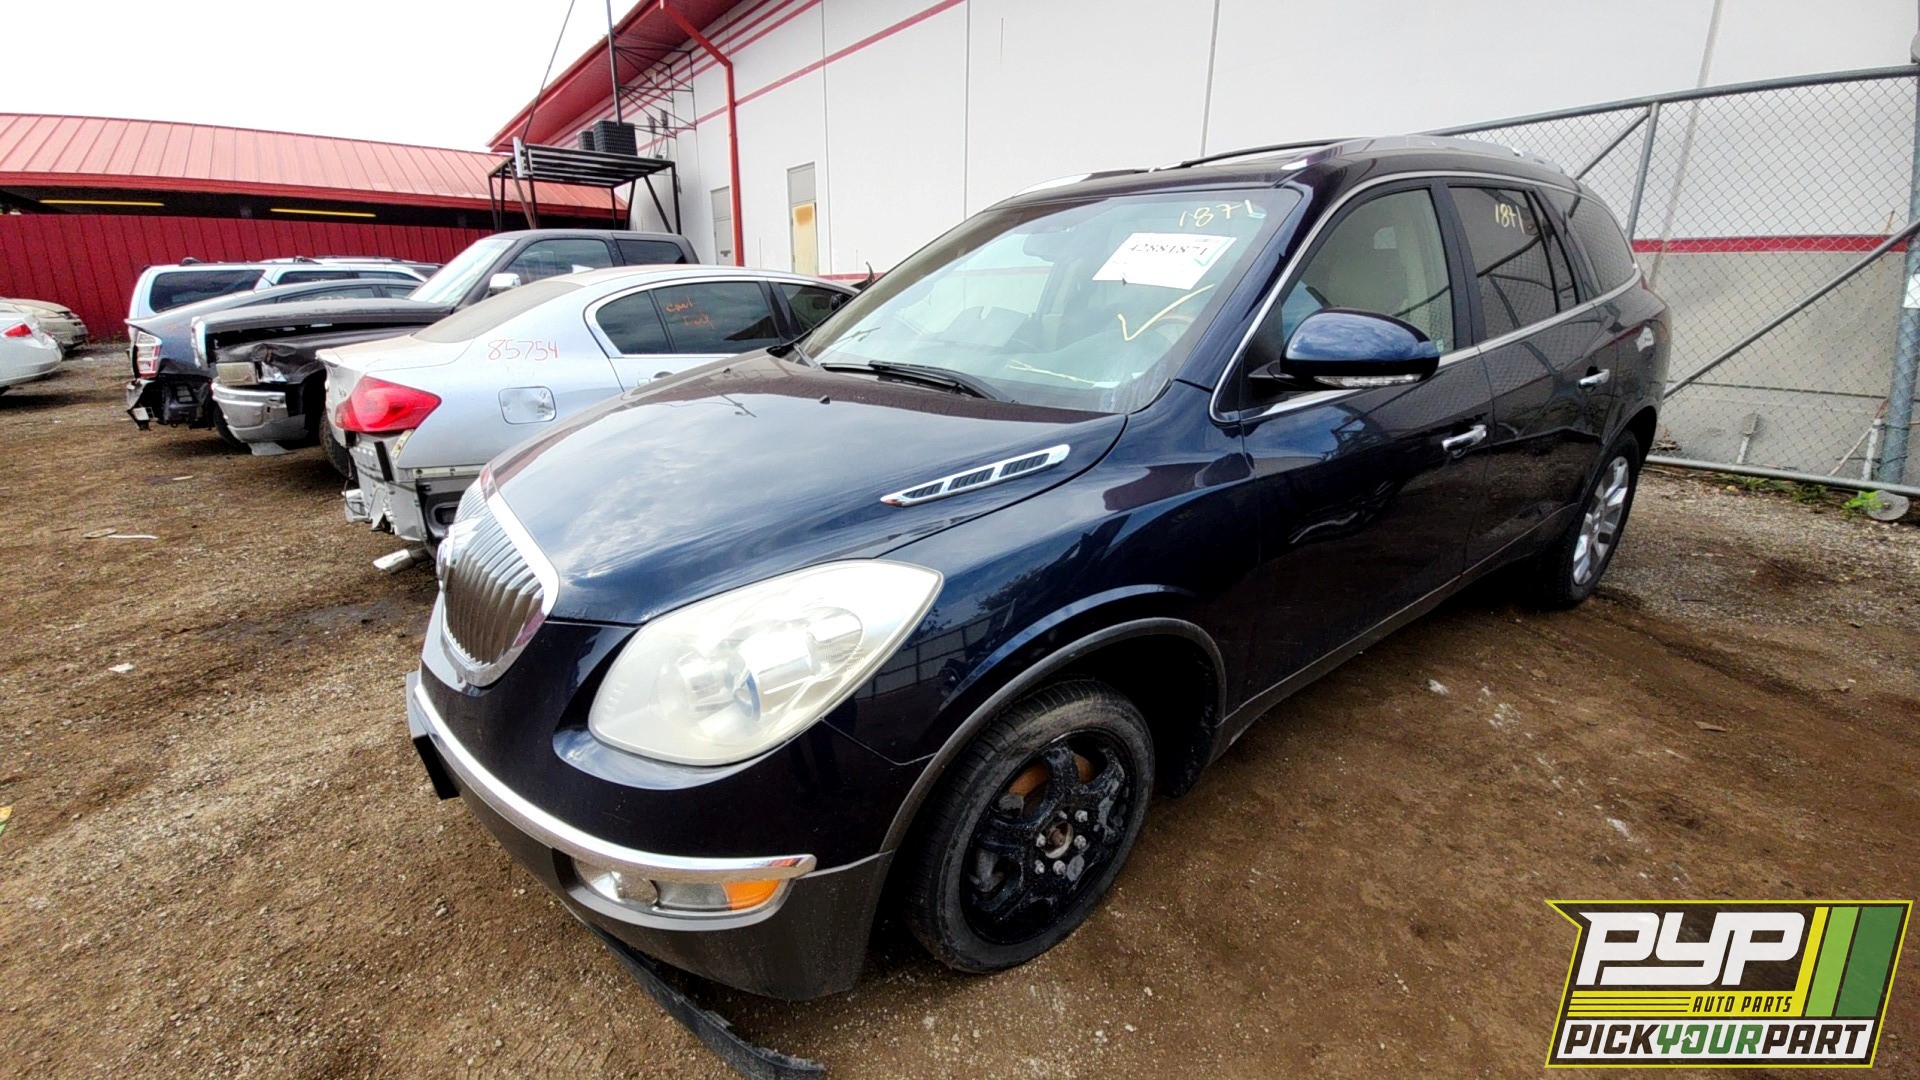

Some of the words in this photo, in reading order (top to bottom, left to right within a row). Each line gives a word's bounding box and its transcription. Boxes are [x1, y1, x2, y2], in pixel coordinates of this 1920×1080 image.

[1179, 199, 1254, 228] 1871
[1494, 203, 1526, 234] 1871
[487, 338, 559, 361] 85754
